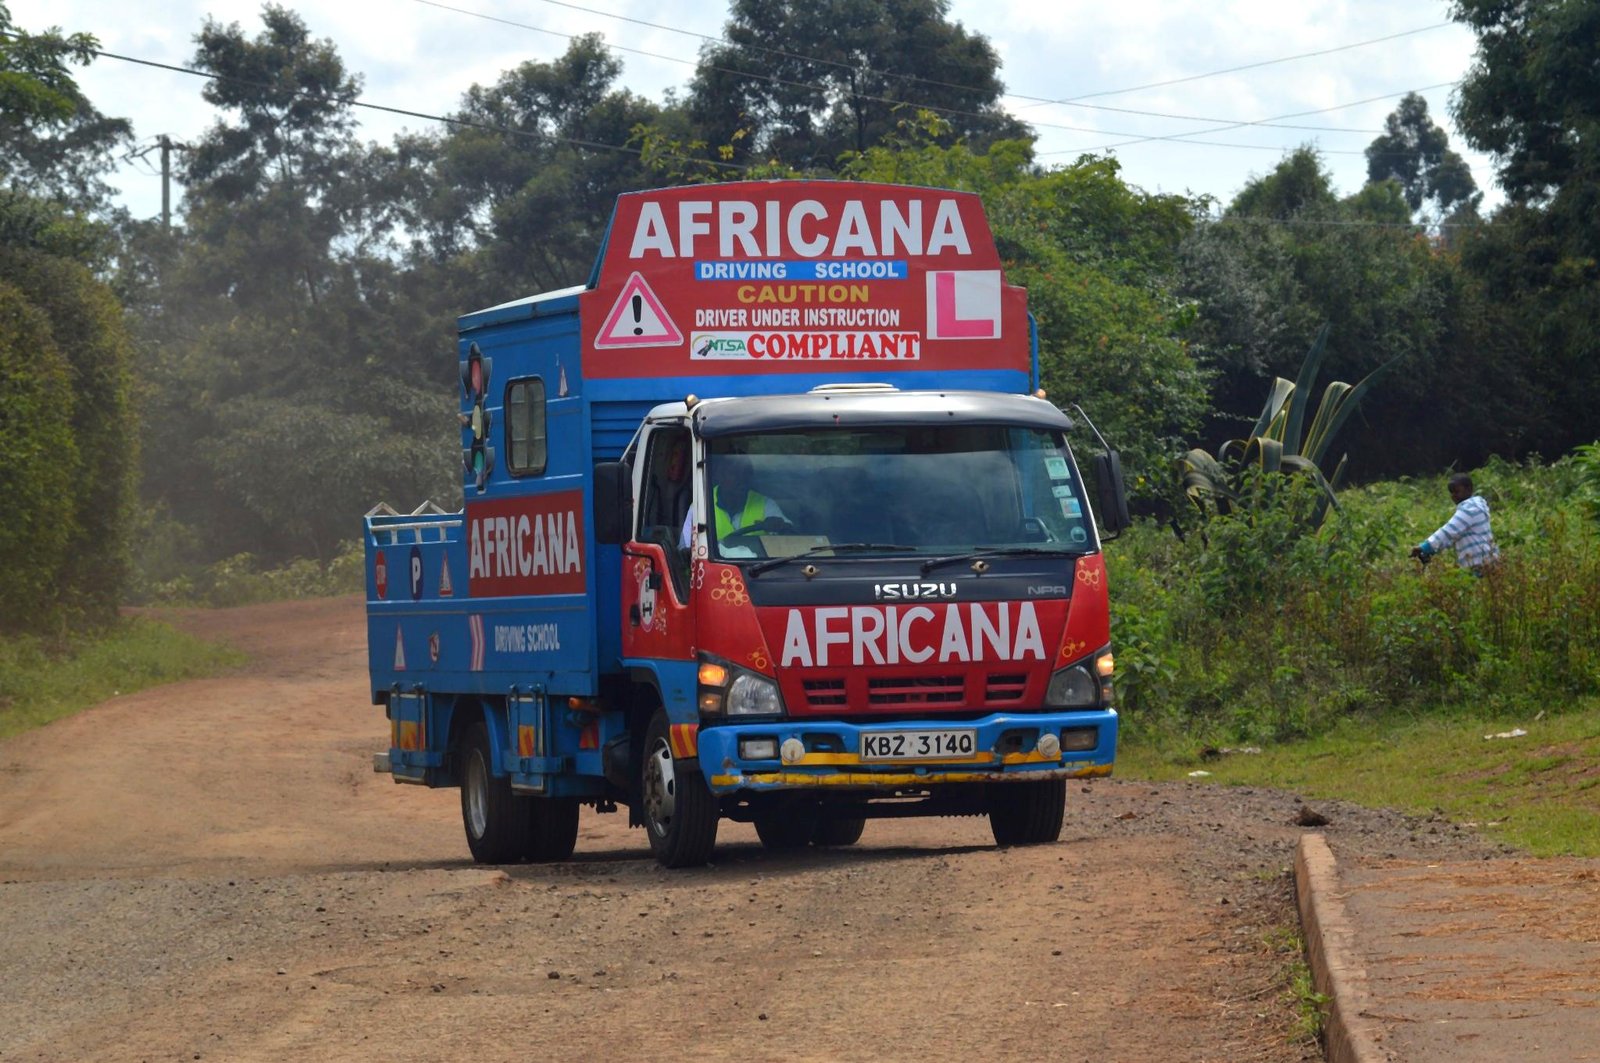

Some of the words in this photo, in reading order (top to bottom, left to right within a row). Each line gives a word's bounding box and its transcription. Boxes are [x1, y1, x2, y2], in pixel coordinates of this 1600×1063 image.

[629, 199, 972, 259] AFRICANA
[700, 262, 787, 279] DRIVING
[815, 261, 899, 279] SCHOOL
[737, 285, 869, 303] CAUTION
[936, 272, 994, 337] L
[695, 309, 747, 327] DRIVER
[752, 309, 800, 327] UNDER
[804, 308, 900, 327] INSTRUCTION
[709, 339, 746, 352] NTSA
[747, 333, 920, 359] COMPLIANT
[470, 511, 581, 578] AFRICANA
[412, 557, 421, 594] P
[874, 583, 957, 599] ISUZU
[494, 625, 526, 652] DRIVING
[527, 623, 560, 652] SCHOOL
[781, 602, 1046, 667] AFRICANA
[864, 735, 905, 756] KBZ
